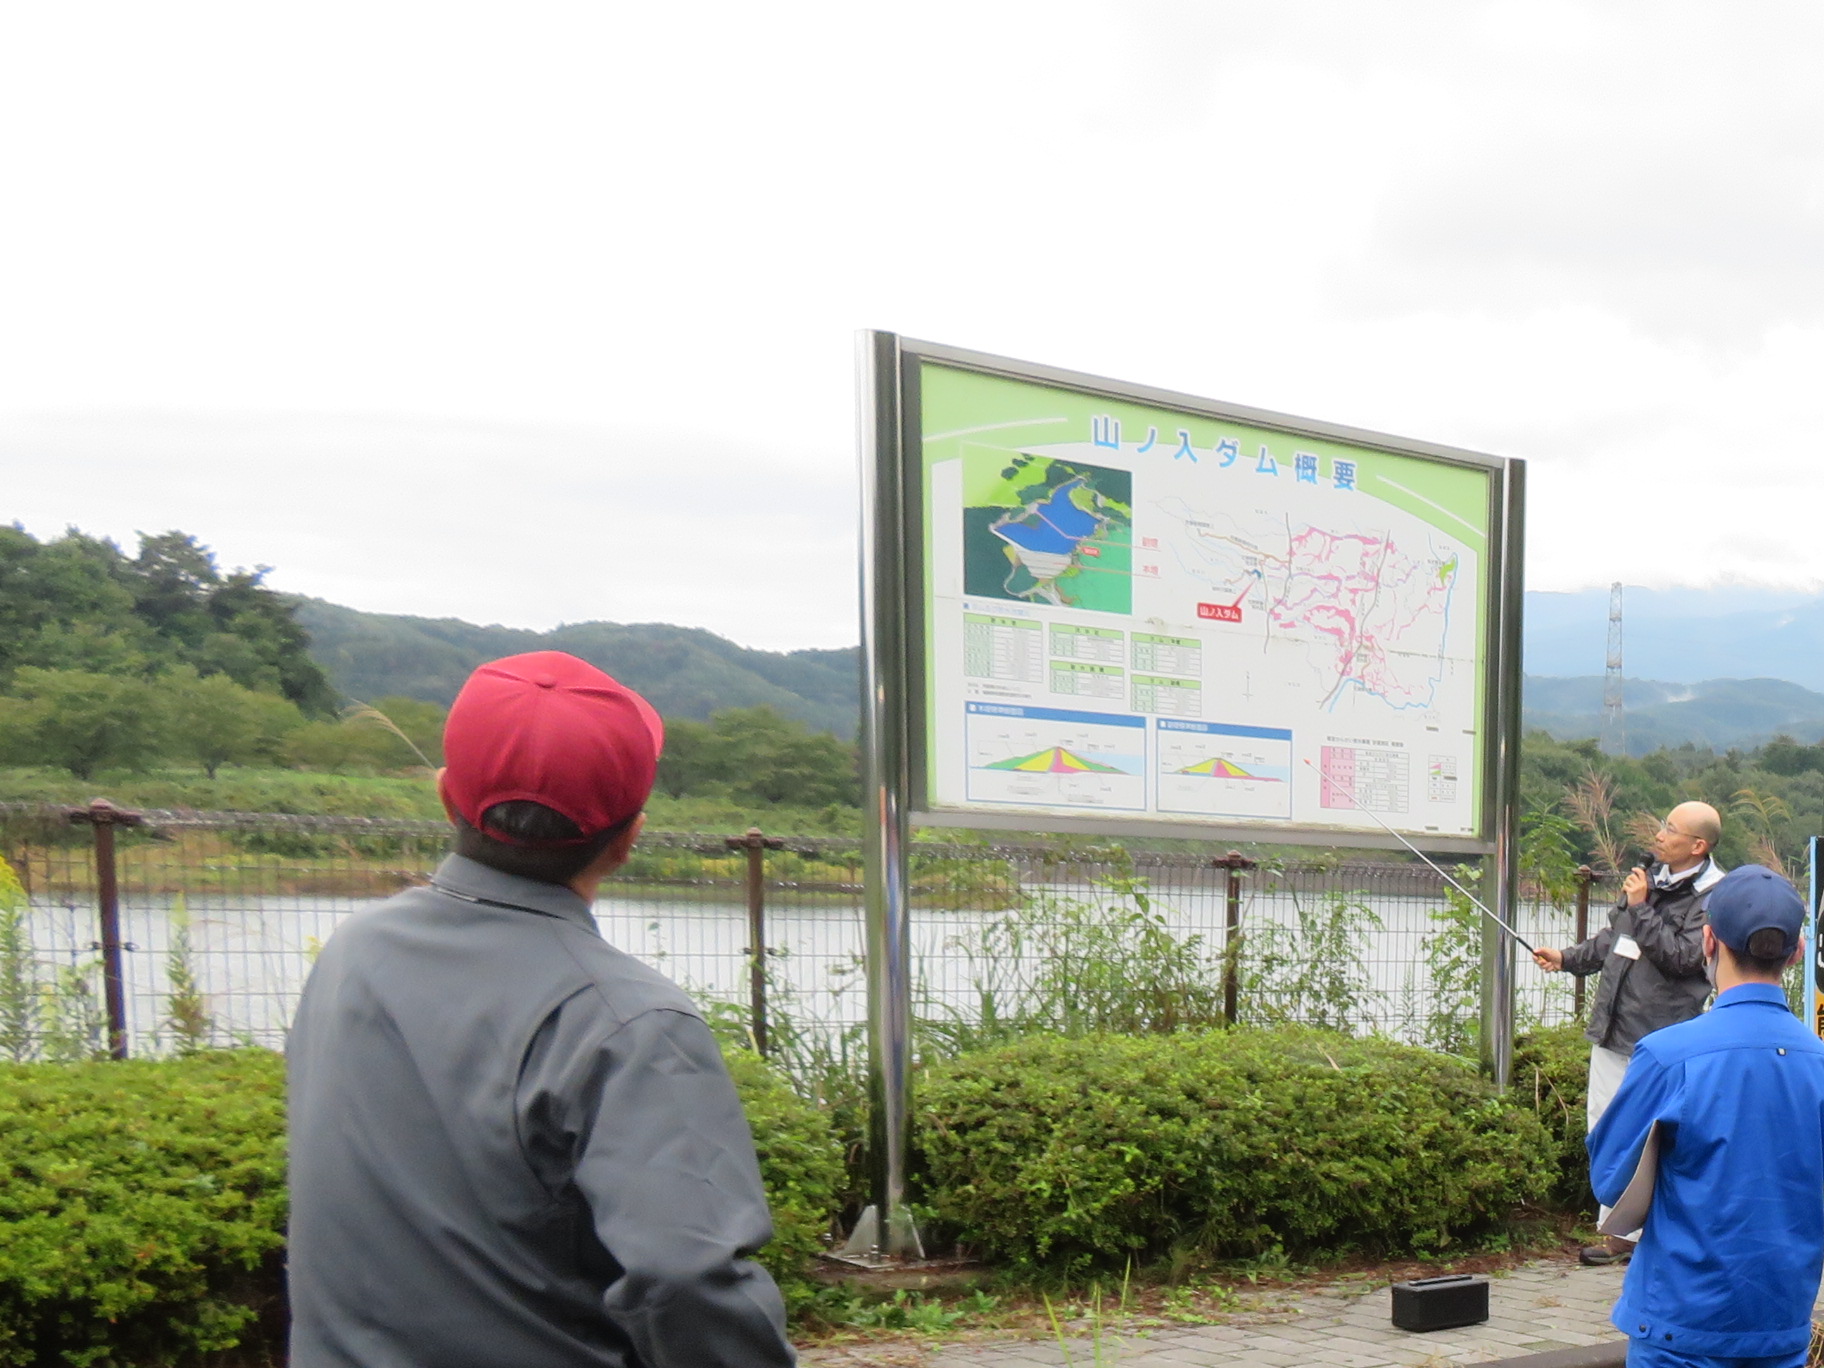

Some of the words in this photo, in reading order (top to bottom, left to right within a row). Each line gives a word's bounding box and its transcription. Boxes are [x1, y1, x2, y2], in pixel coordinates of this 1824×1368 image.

[1092, 416, 1356, 492] 山ノ入ダム概要
[1199, 605, 1240, 621] 山ノ入ダム
